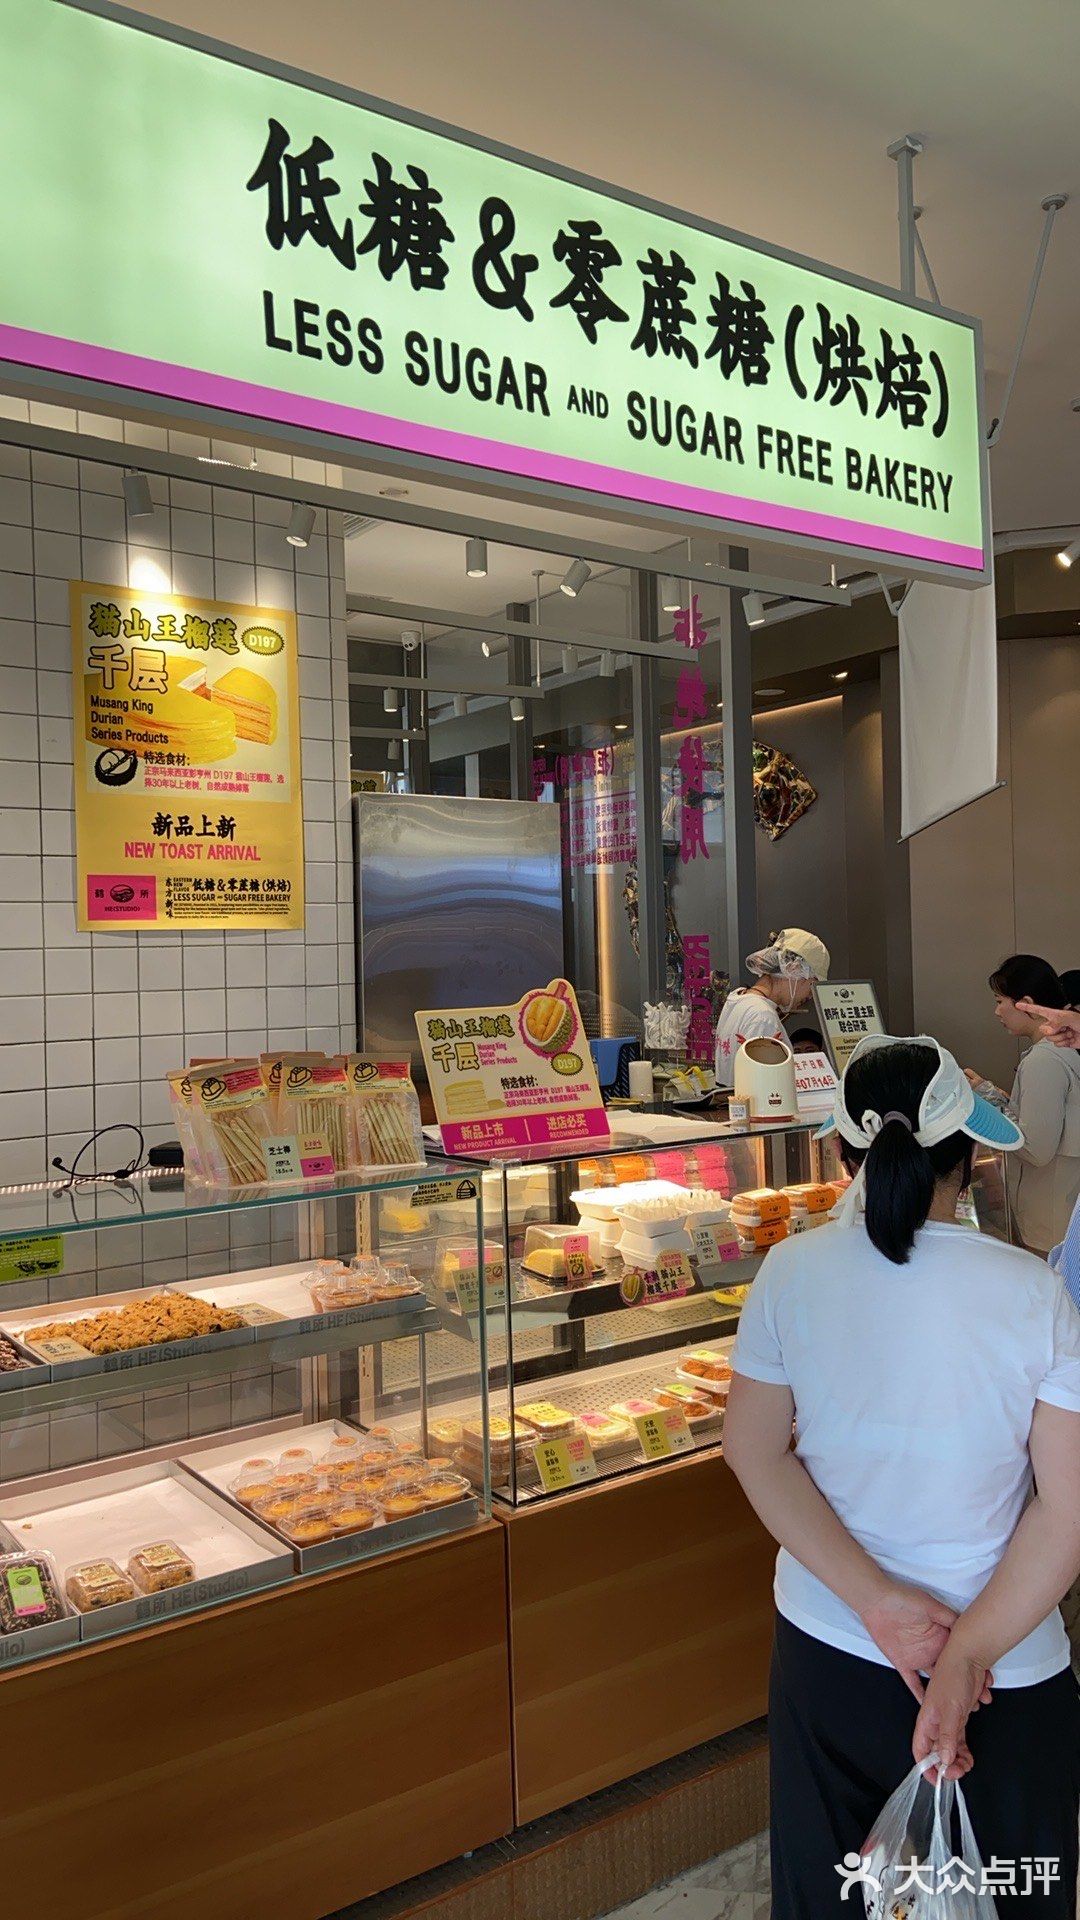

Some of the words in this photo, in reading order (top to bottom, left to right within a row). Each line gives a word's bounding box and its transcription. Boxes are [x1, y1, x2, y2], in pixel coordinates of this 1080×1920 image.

[246, 118, 949, 438] 低糖&零蔗糖(烘焙)
[263, 290, 384, 375] LESS
[404, 330, 550, 416] SUGAR
[567, 385, 609, 419] AND
[627, 391, 745, 465] SUGAR
[757, 425, 833, 485] FREE
[846, 447, 953, 513] BAKERY
[88, 644, 168, 694] 千层
[90, 694, 129, 712] Musang
[132, 699, 154, 714] King
[90, 711, 124, 725] Durian
[91, 727, 122, 740] Series
[125, 729, 169, 744] Products
[213, 770, 234, 780] D197
[151, 812, 237, 841] 新品上新
[124, 842, 155, 859] NEW
[159, 843, 203, 860] TOAST
[207, 845, 261, 861] ARRIVAL
[173, 893, 191, 901] LESS
[191, 893, 216, 902] SUGAR
[224, 893, 247, 902] SUGAR
[247, 894, 265, 902] FREE
[265, 894, 291, 902] BAKERY
[432, 1041, 480, 1073] 千层
[557, 1057, 578, 1070] D197
[453, 1143, 467, 1151] NEW
[467, 1139, 494, 1149] PRODUCT
[494, 1136, 517, 1146] ARRIVAL
[549, 1128, 590, 1138] RECOMMENDED
[460, 1121, 504, 1140] 新品上市
